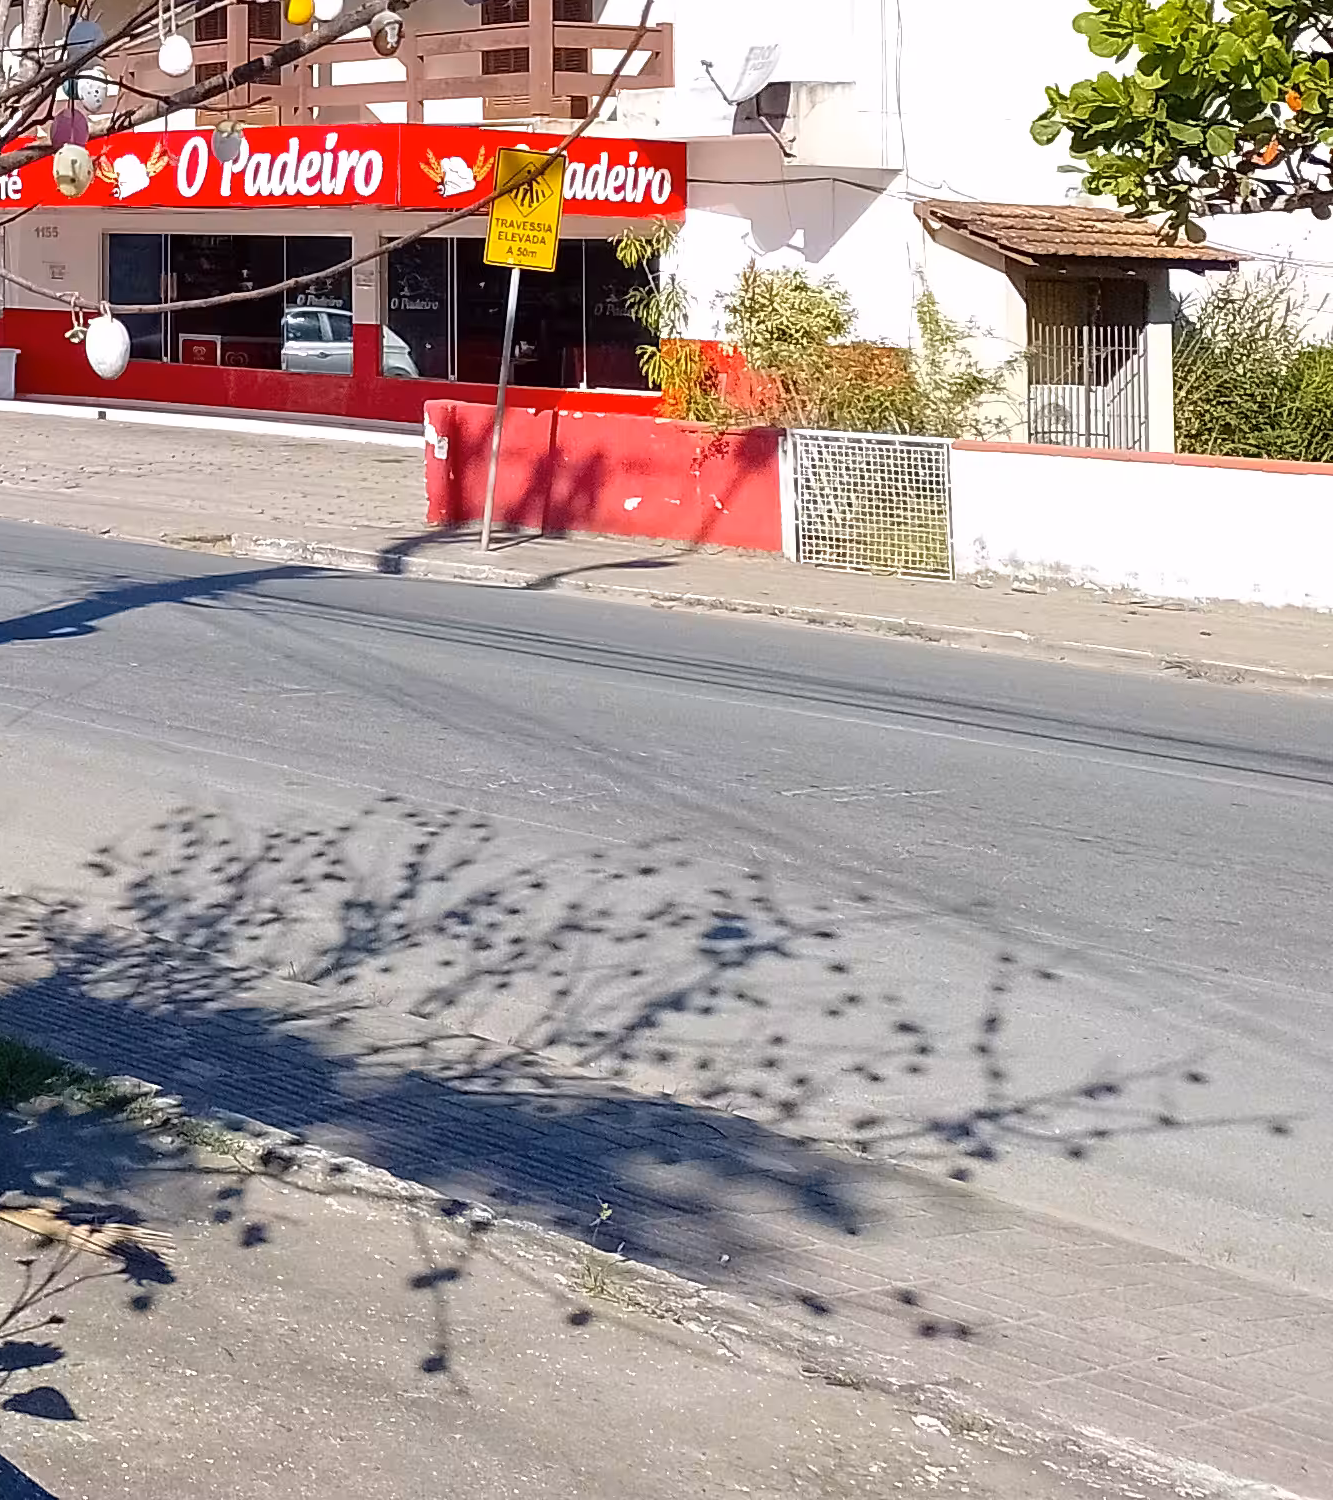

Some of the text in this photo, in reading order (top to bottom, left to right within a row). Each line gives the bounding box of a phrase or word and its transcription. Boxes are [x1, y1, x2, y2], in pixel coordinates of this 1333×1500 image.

[177, 132, 383, 197] O Padeiro
[547, 147, 672, 205] adeiro
[34, 226, 59, 238] 1155
[495, 218, 553, 233] TRAVESSIA
[497, 231, 546, 245] ELEVADA
[506, 245, 537, 258] A 50m
